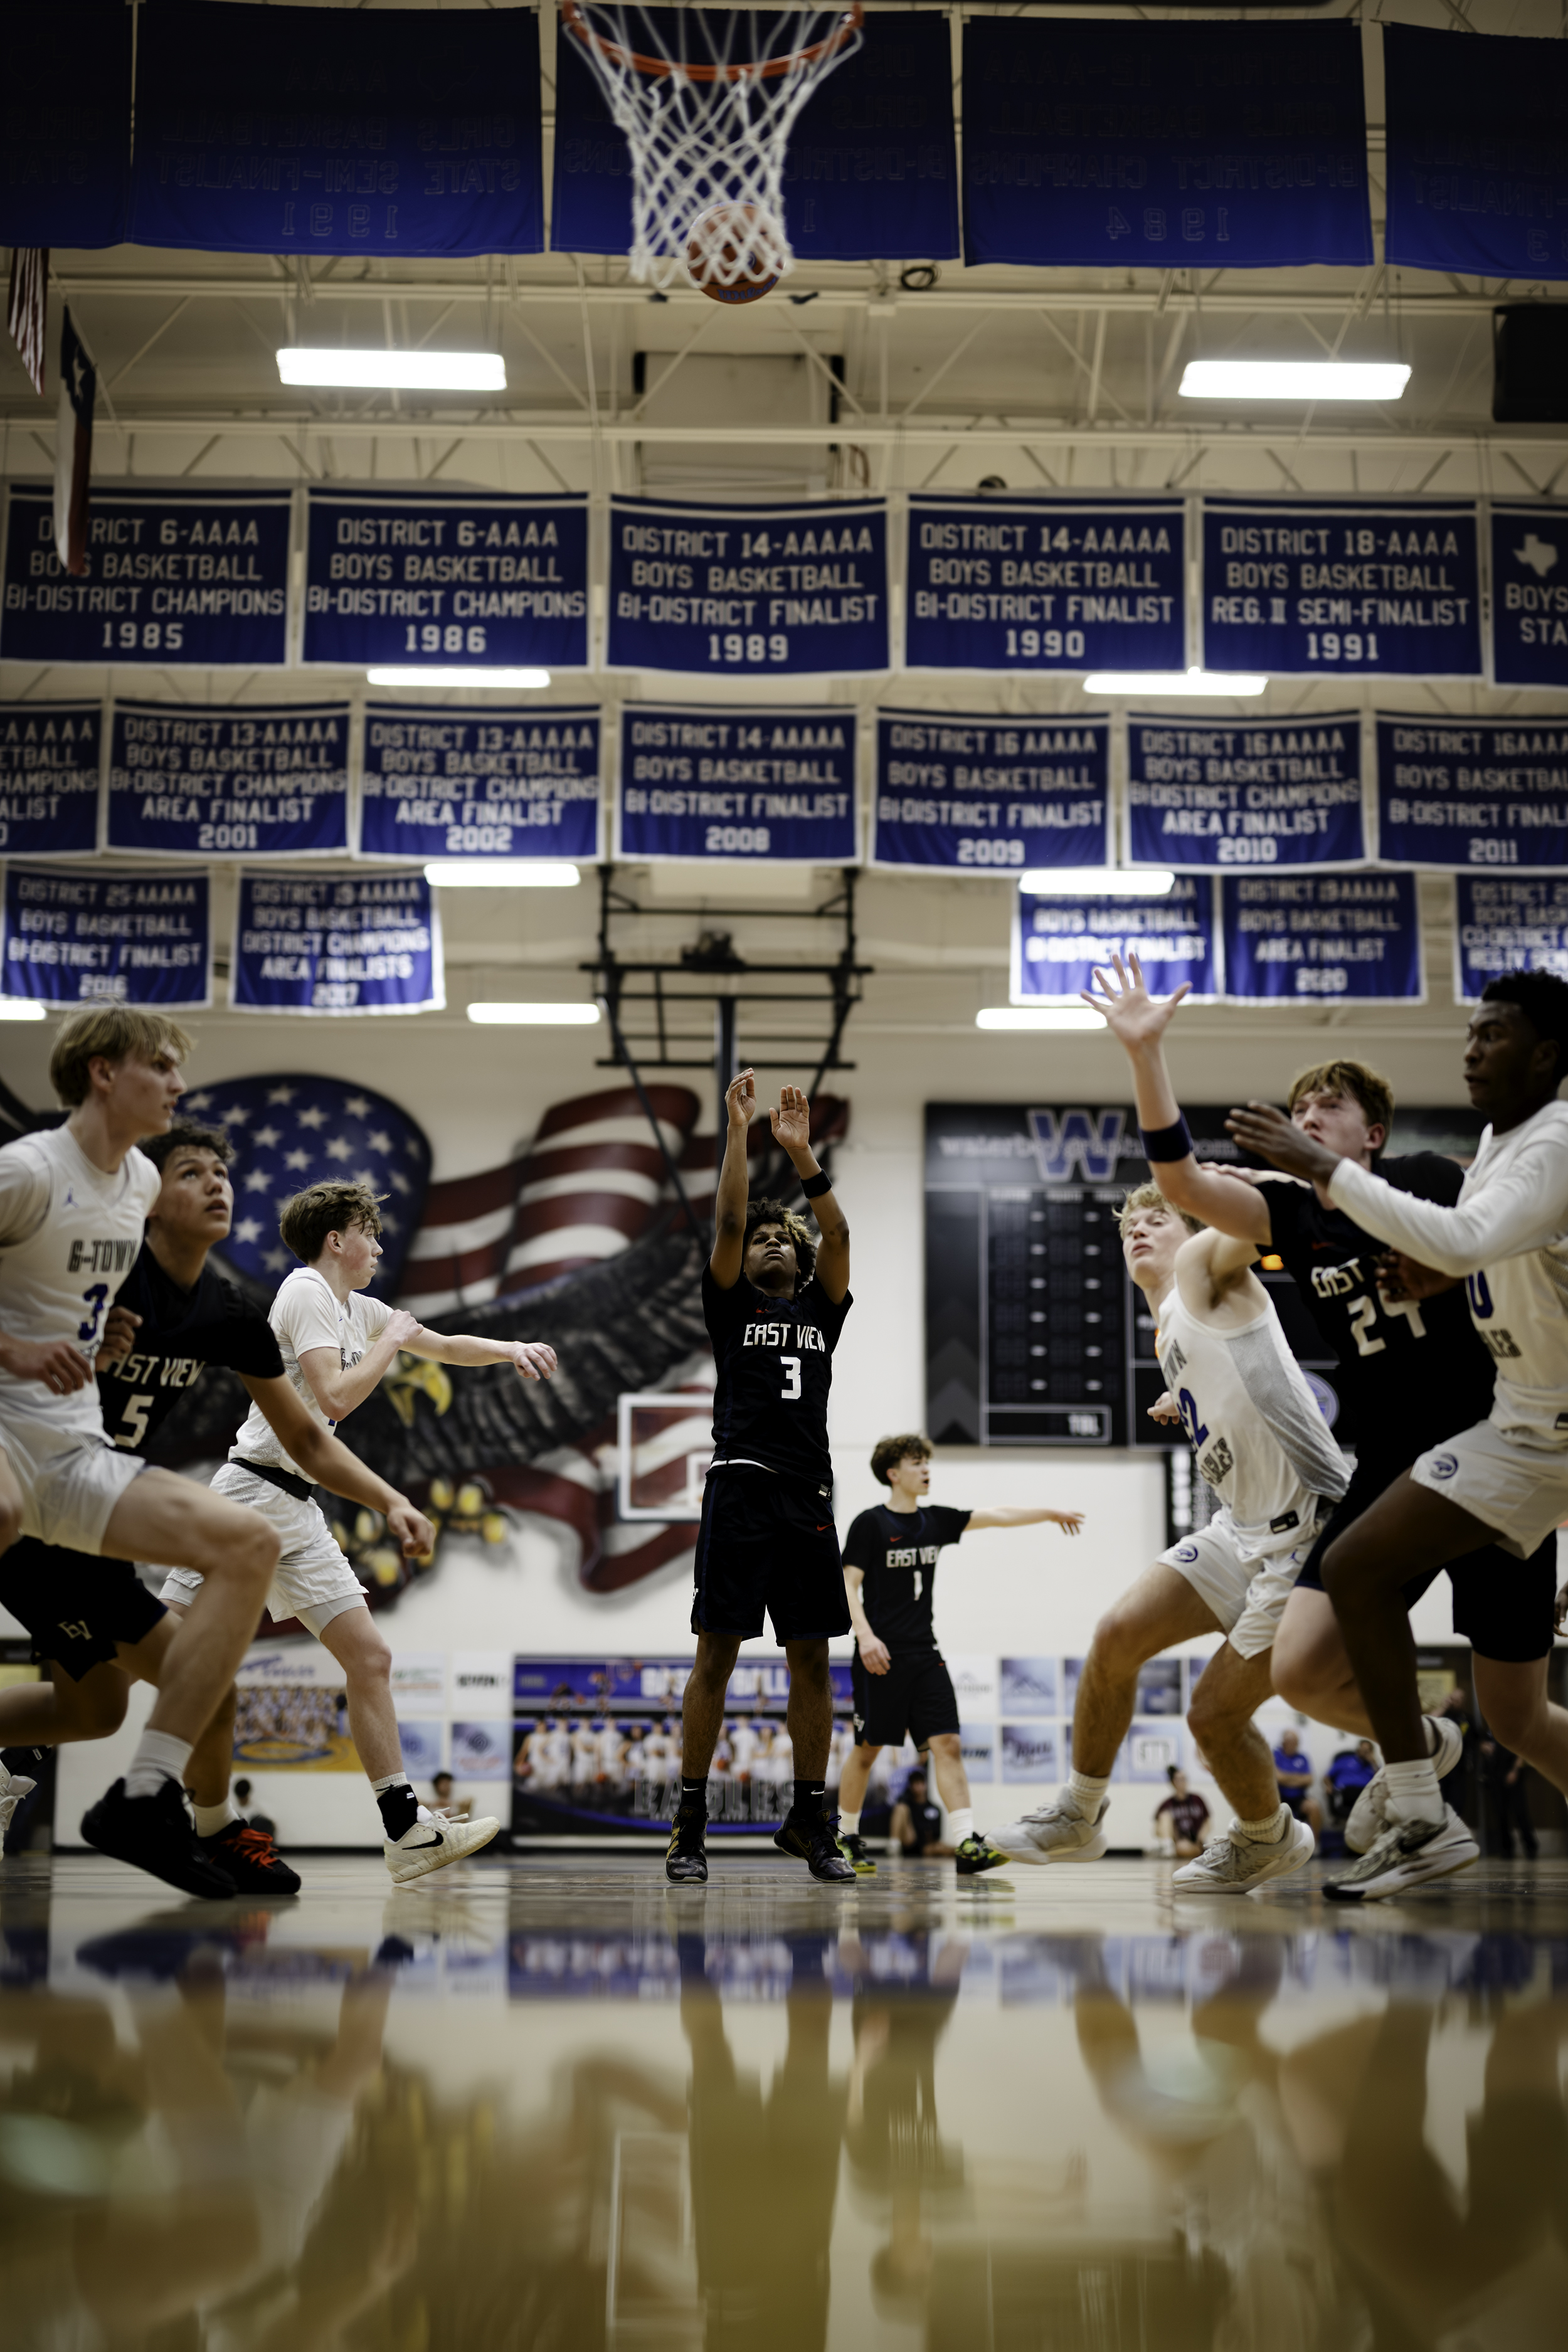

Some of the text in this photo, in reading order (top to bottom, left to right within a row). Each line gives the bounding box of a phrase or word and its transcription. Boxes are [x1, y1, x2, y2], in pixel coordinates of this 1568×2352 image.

[161, 519, 259, 545] 6-AAAA
[337, 518, 558, 547] DISTRICT 6-AAAA
[623, 526, 873, 558] DISTRICT 14-AAAAA
[920, 522, 1170, 554] DISTRICT 14-AAAAA
[1221, 527, 1459, 557] DISTRICT 18-AAAA
[102, 553, 262, 581] BASKETBALL
[330, 553, 563, 582] BOYS BASKETBALL
[632, 560, 864, 593] BOYS BASKETBALL
[929, 559, 1160, 589] BOYS BASKETBALL
[1227, 562, 1455, 592] BOYS BASKETBALL
[6, 583, 285, 615] BI-DISTRICT CHAMPIONS
[307, 586, 586, 618] BI-DISTRICT CHAMPIONS
[617, 591, 877, 626] BI-DISTRICT FINALIST
[915, 591, 1175, 623] BI-DISTRICT FINALIST
[1298, 597, 1470, 626] SEMI-FINALIST
[102, 622, 184, 649] 1985
[405, 625, 487, 653] 1986
[1005, 629, 1085, 658] 1990
[1520, 618, 1568, 645] STA
[709, 634, 788, 662] 1989
[1306, 632, 1380, 660] 1991
[125, 718, 339, 746] DISTRICT 13-AAAAA
[371, 723, 593, 751] DISTRICT 13-AAAAA
[632, 722, 730, 749] DISTRICT
[891, 725, 989, 752] DISTRICT
[1142, 729, 1236, 756] DISTRICT
[1393, 728, 1483, 756] DISTRICT
[0, 746, 78, 769] ETBALL
[127, 743, 332, 772] BOYS BASKETBALL
[381, 749, 582, 776] BOYS BASKETBALL
[634, 756, 841, 785] BOYS BASKETBALL
[1145, 756, 1345, 783] BOYS BASKETBALL
[0, 769, 98, 793] HAMPIONS
[110, 767, 347, 797] BI-DISTRICT CHAMPIONS
[364, 771, 599, 802] BI-DISTRICT CHAMPIONS
[888, 761, 1096, 792] BOYS BASKETBALL
[1395, 764, 1568, 793] BOYS BASKETBAL
[625, 788, 849, 819] BI-DISTRICT FINALIST
[1131, 778, 1361, 809] BI-DISTRICT CHAMPIONS
[142, 797, 315, 823] AREA FINALIST
[396, 800, 565, 827] AREA FINALIST
[879, 797, 1104, 829] BI-DISTRICT FINALIST
[1162, 809, 1330, 836] AREA FINALIST
[1389, 798, 1501, 827] BI-DISTRICT
[198, 824, 258, 849] 2001
[446, 825, 513, 852] 2002
[1217, 836, 1278, 863] 2010
[1470, 837, 1518, 864] 2011
[956, 839, 1026, 865] 2009
[18, 877, 98, 905] DISTRICT
[20, 908, 193, 938] BOYS BASKETBALL
[253, 905, 422, 931] BOYS BASKETBALL
[1237, 909, 1402, 933] BOYS BASKETBALL
[1255, 938, 1385, 964] AREA FINALIST
[1311, 1257, 1365, 1298] EAST
[78, 1283, 109, 1341] 3
[743, 1322, 792, 1347] EAST
[780, 1356, 802, 1400] 3
[114, 1392, 156, 1449] 5
[886, 1548, 918, 1568] EAST
[913, 1570, 923, 1601] 1
